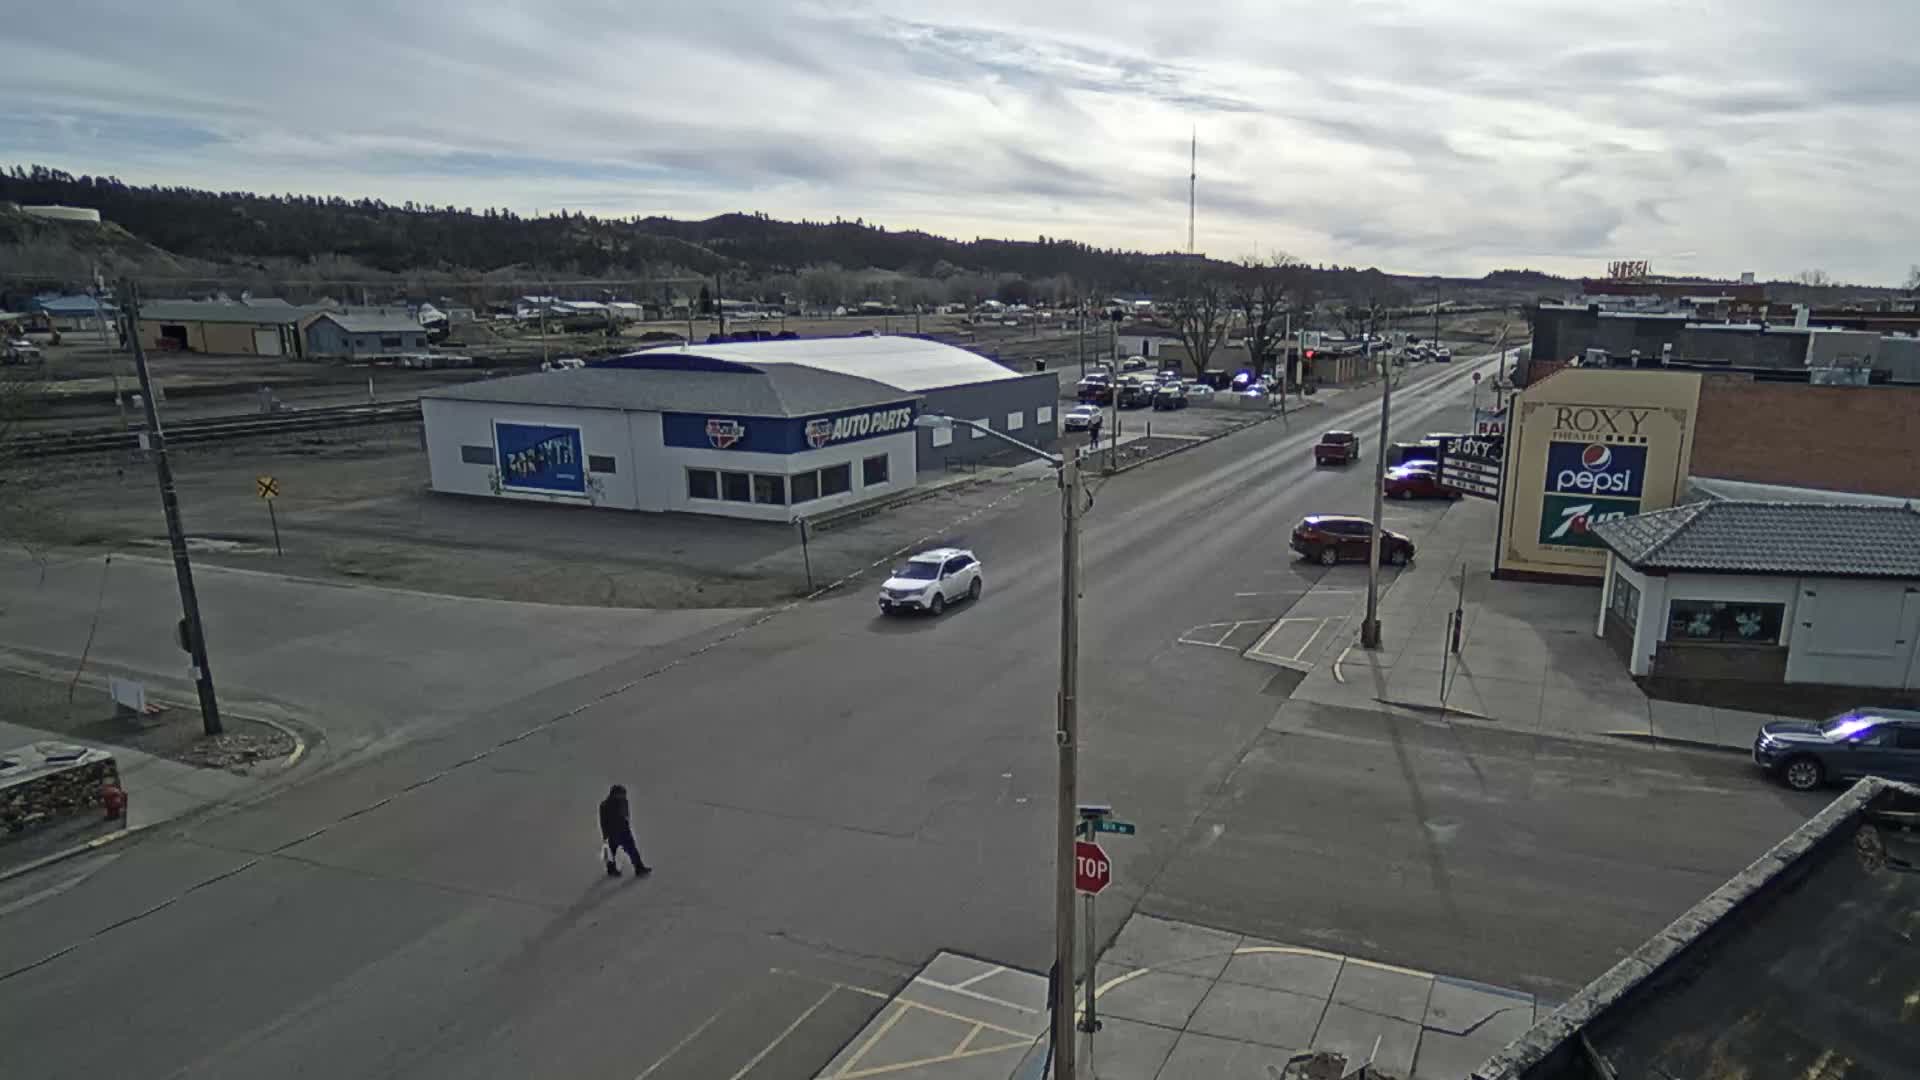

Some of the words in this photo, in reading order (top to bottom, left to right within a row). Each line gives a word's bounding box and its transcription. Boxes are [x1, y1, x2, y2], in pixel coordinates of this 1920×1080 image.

[832, 413, 869, 440] AUTO
[870, 407, 911, 433] PARTS
[1552, 407, 1648, 434] ROXY
[1557, 469, 1630, 493] pepsi
[1077, 856, 1107, 879] TOP
